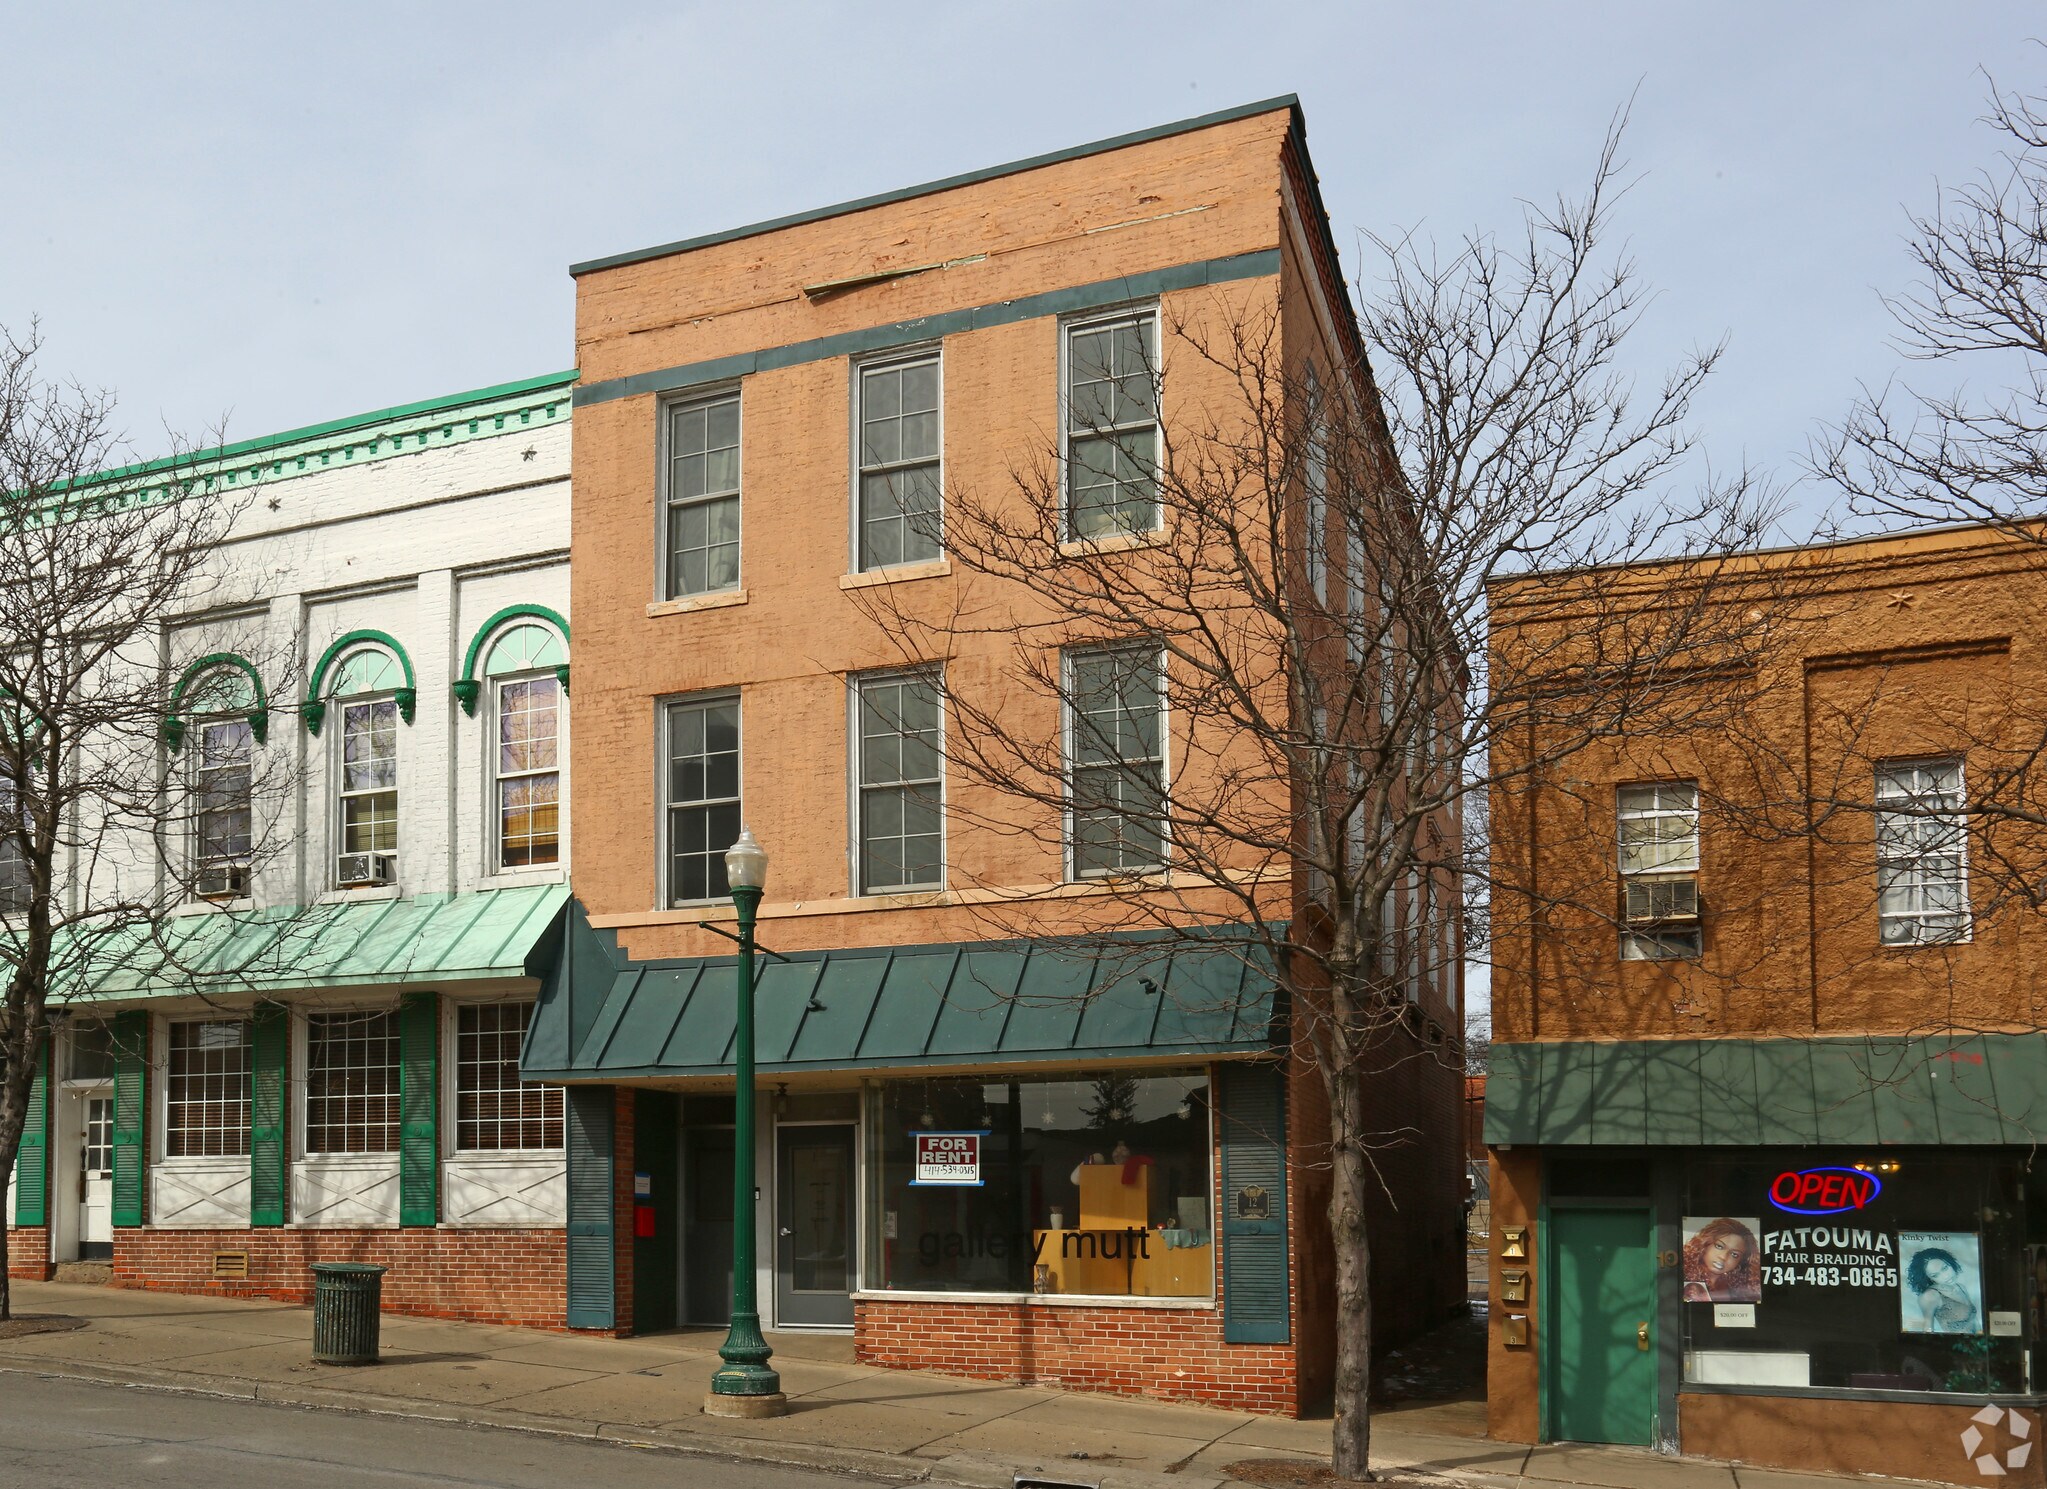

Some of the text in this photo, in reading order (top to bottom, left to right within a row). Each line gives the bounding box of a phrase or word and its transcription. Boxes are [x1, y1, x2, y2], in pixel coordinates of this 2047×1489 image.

[928, 1138, 967, 1151] FOR
[921, 1151, 974, 1164] RENT
[1771, 1171, 1870, 1209] OPEN
[1249, 1197, 1258, 1207] 12
[1763, 1226, 1894, 1256] FATOUMA
[1902, 1233, 1949, 1242] Kinky Twist
[918, 1226, 1150, 1267] gallery mutt
[1656, 1250, 1678, 1269] 10
[1774, 1252, 1886, 1266] HAIR BRAIDING
[1761, 1266, 1898, 1287] 734-483-0855
